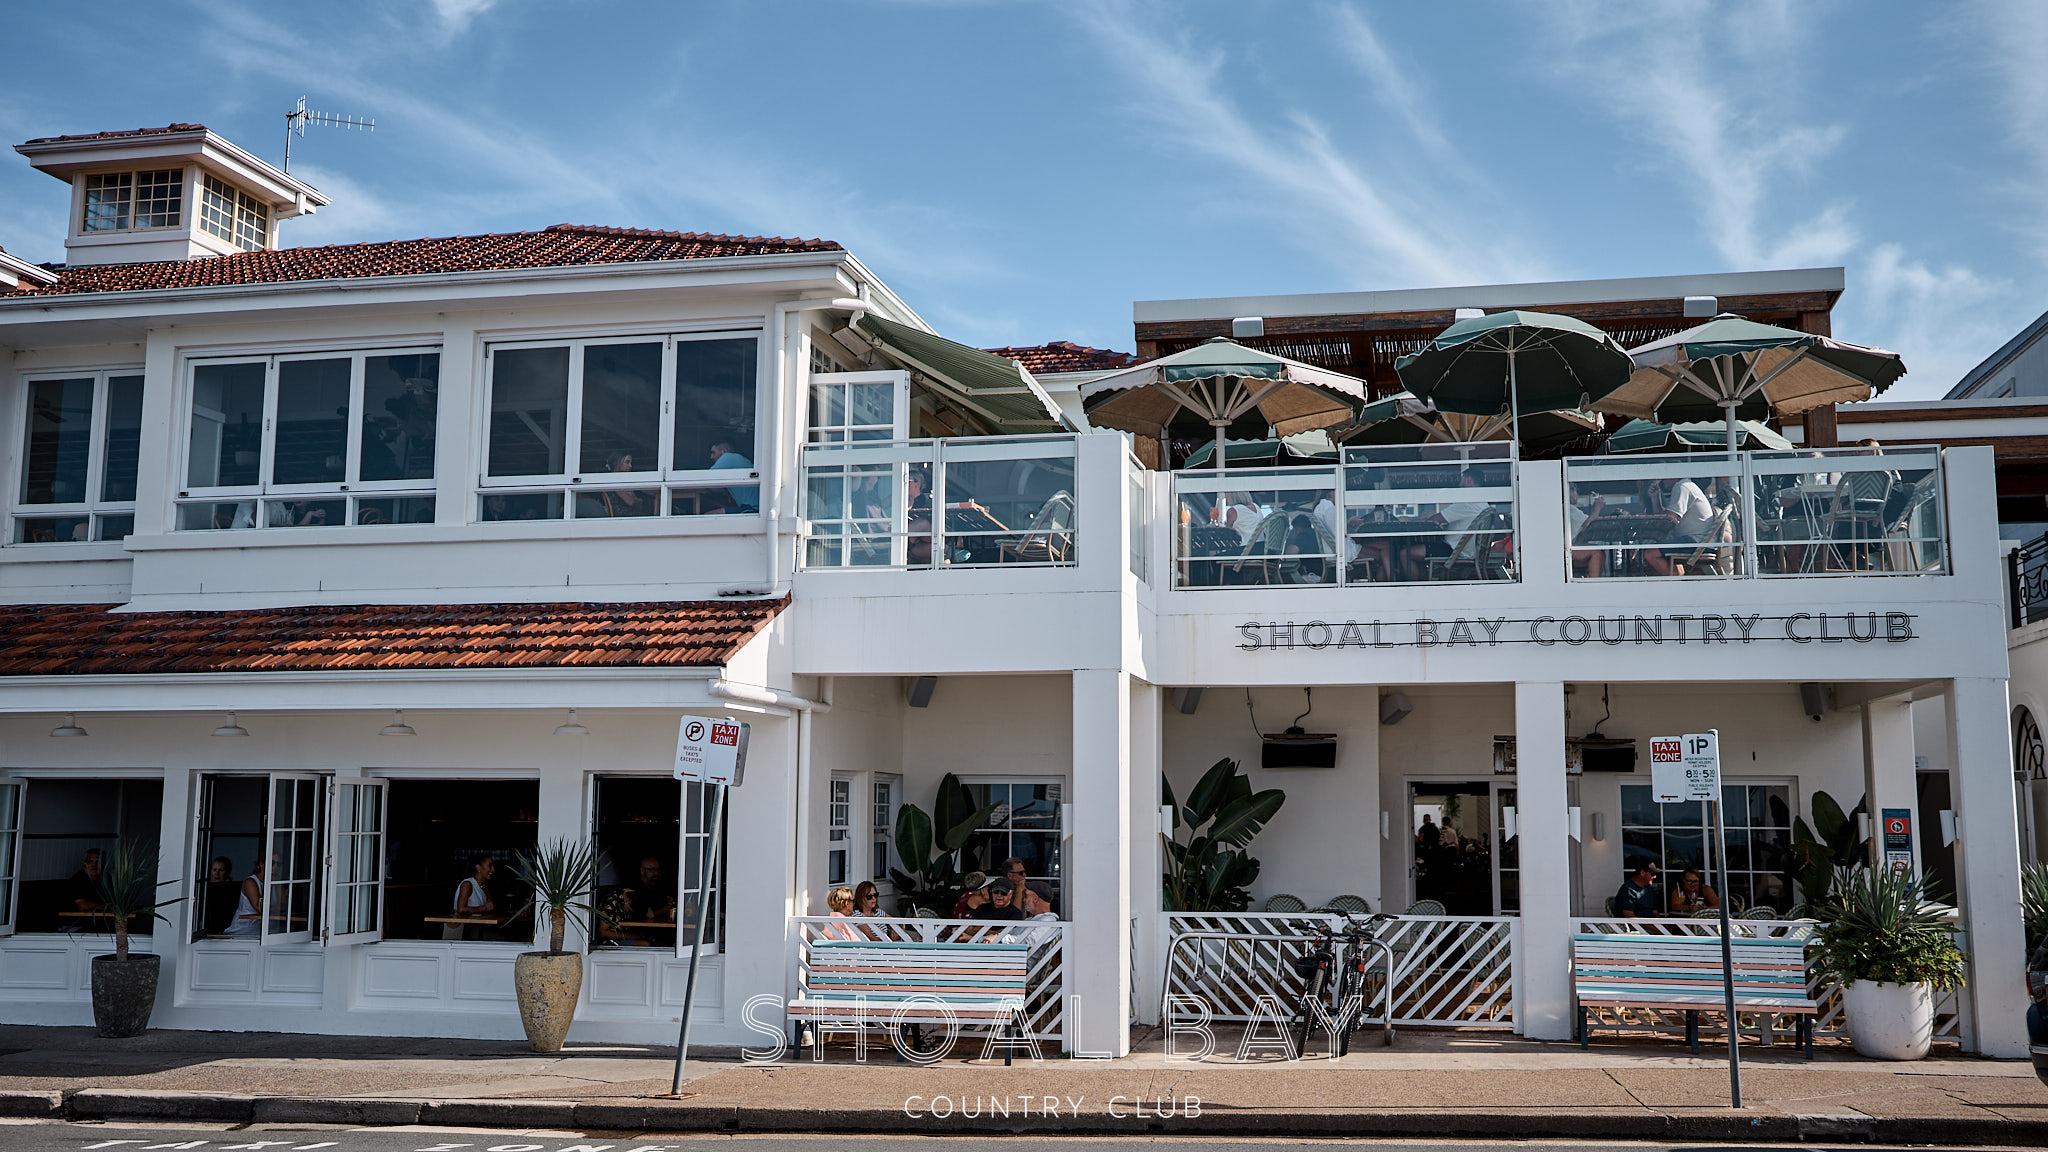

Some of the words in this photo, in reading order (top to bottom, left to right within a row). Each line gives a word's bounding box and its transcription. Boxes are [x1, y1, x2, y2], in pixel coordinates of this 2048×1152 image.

[1241, 620, 1394, 651] SHOAL
[1415, 617, 1505, 648] BAY
[1530, 613, 1760, 646] COUNTRY
[1784, 611, 1913, 644] CLUB
[714, 725, 736, 735] TAXI
[714, 735, 734, 744] ZONE
[1654, 743, 1678, 751] TAXI
[1689, 739, 1708, 754] 1P
[1654, 753, 1680, 761] ZONE
[80, 1139, 340, 1150] TAXI
[414, 1142, 680, 1152] ZONE
